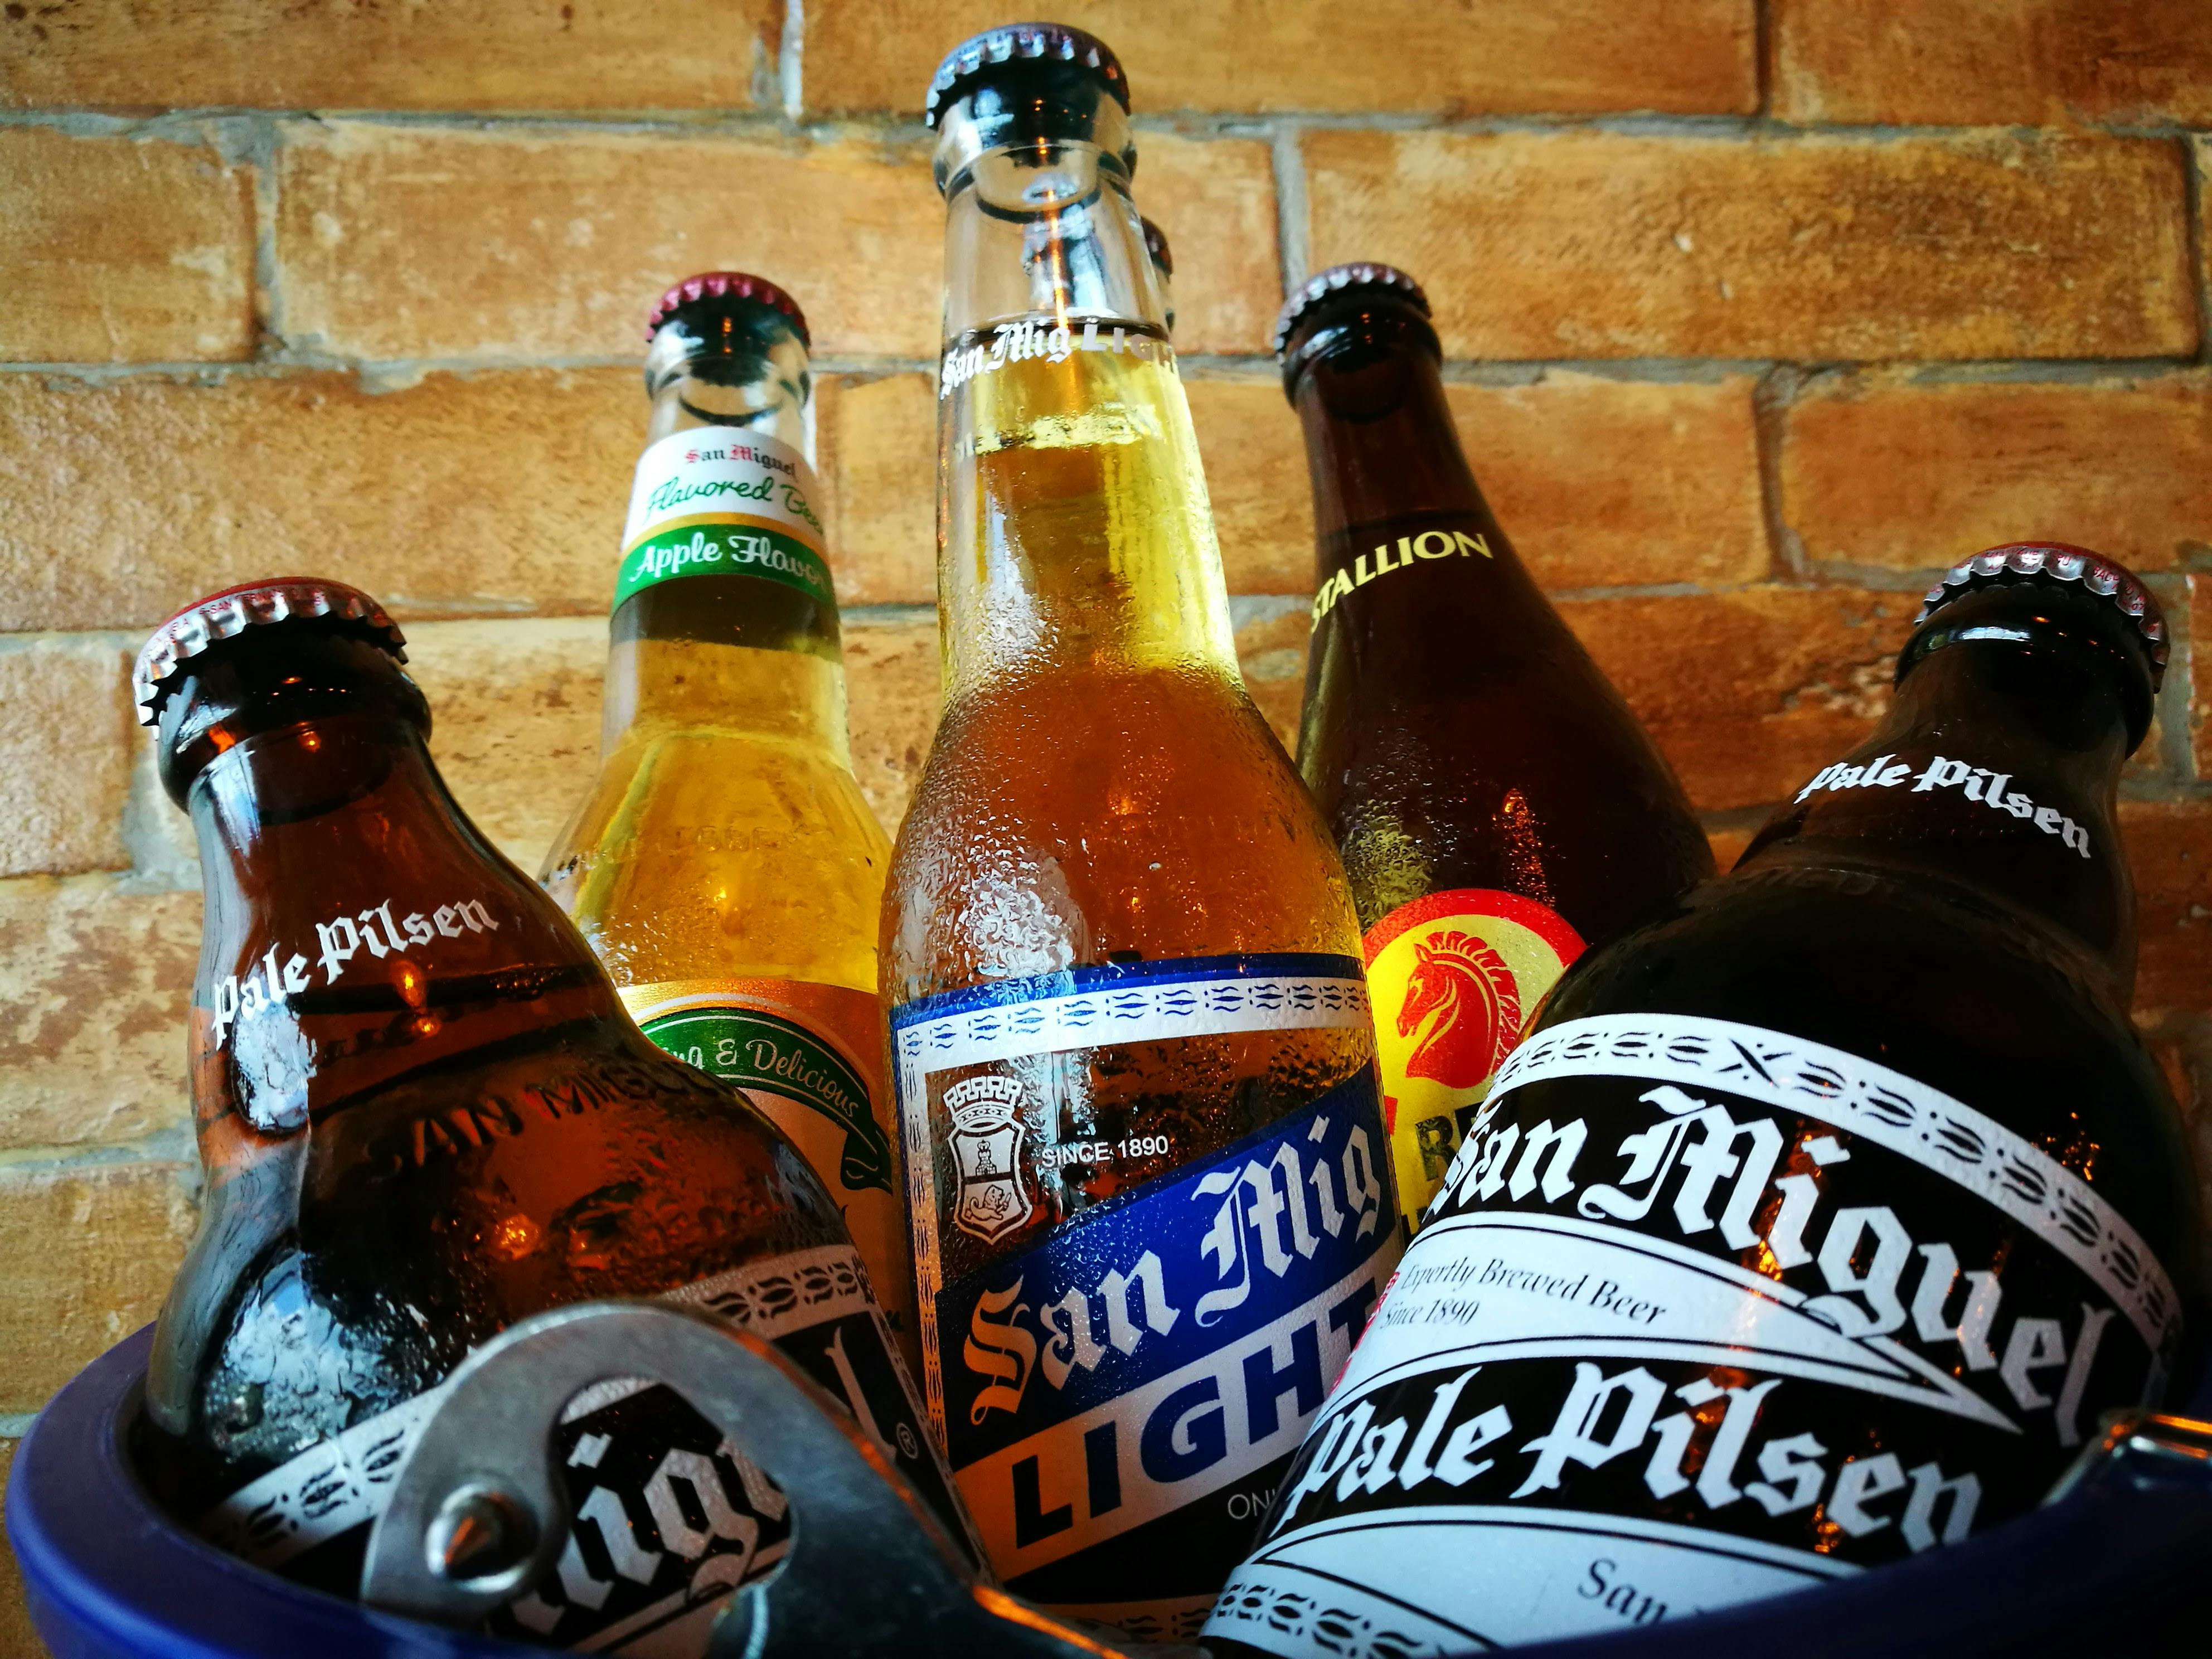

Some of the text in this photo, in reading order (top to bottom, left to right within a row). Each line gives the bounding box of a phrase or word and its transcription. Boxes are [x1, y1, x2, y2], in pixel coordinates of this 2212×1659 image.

[940, 342, 986, 400] San
[984, 318, 1073, 373] Mig
[685, 444, 798, 484] San Miguel
[642, 477, 775, 526] Flavored
[629, 532, 723, 583] Apple
[1311, 531, 1493, 634] STALLION
[1793, 754, 2091, 859] Pale Pilsen
[211, 898, 499, 1051] Pale Pilsen
[745, 1039, 860, 1118] Delicious
[1041, 1134, 1169, 1168] SINCE 1890
[963, 1250, 1181, 1425] San
[1191, 1115, 1382, 1328] Mig
[1400, 1256, 1666, 1325] Expertly Brewed Beer
[1422, 1085, 2116, 1448] San Miguel
[1379, 1298, 1481, 1330] Since 1890
[1268, 1361, 1983, 1554] Pale Pilsen
[1227, 1488, 1276, 1521] ON
[1577, 1558, 1667, 1626] San
